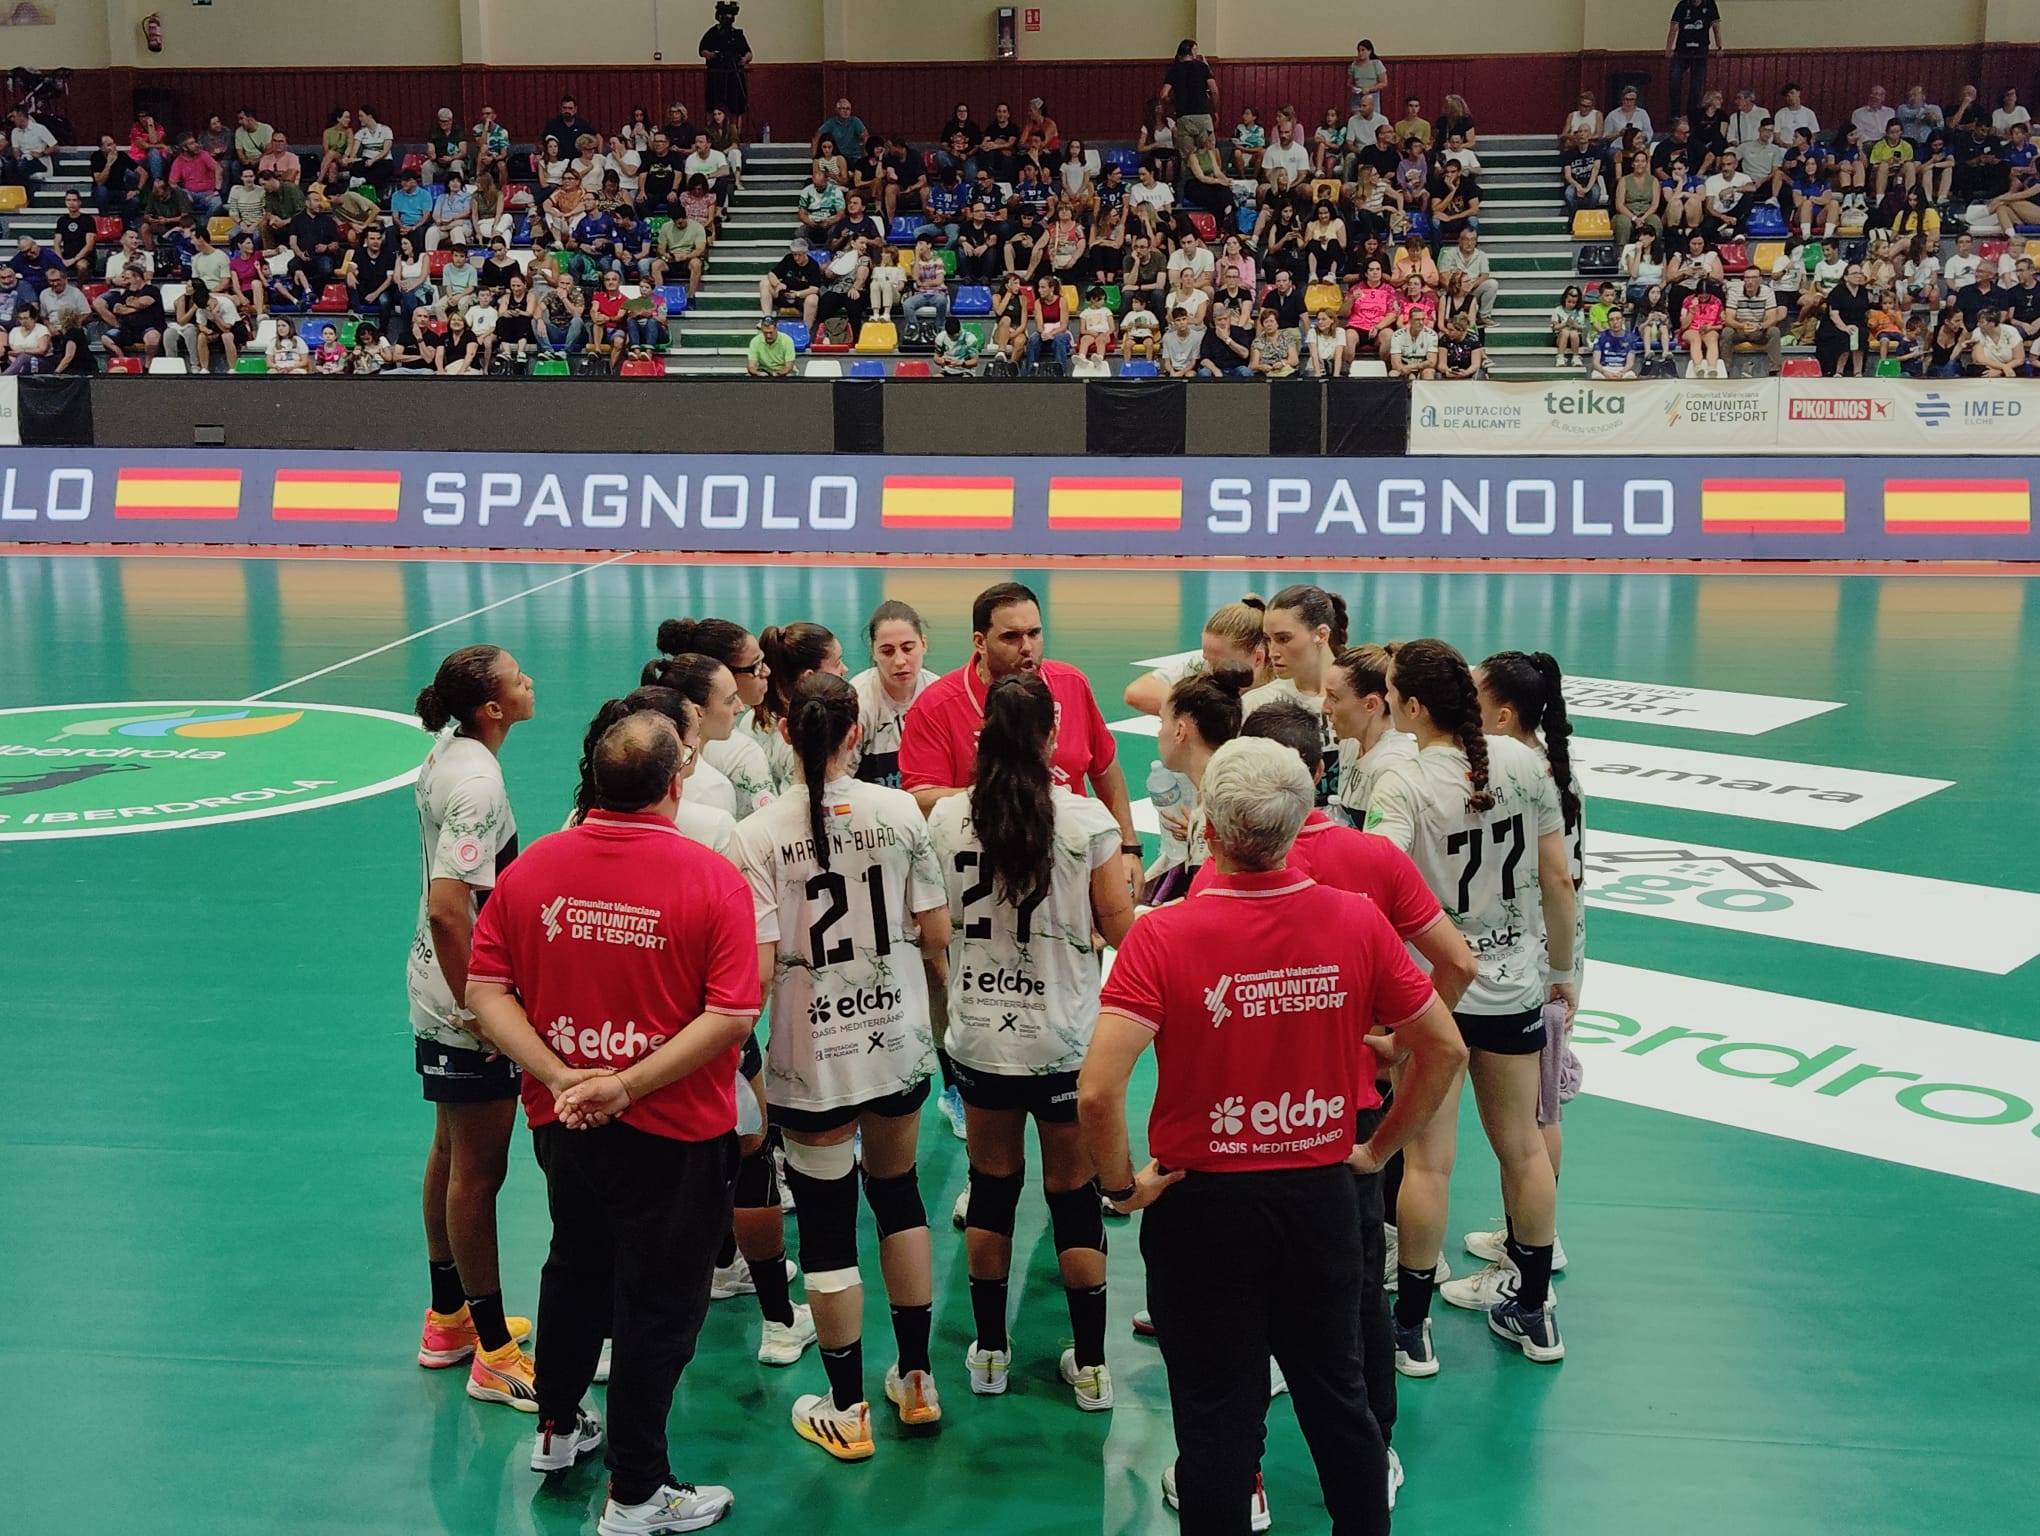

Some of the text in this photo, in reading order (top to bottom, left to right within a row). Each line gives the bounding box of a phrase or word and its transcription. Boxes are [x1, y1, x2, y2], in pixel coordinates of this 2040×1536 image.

[1443, 404, 1521, 416] DIPUTACIÓN
[1544, 389, 1625, 414] teika
[1686, 400, 1759, 411] COMUNITAT
[1792, 400, 1868, 419] PIKOLINOS
[1964, 400, 2022, 417] IMED
[1443, 418, 1521, 429] DE ALICANTE
[1551, 418, 1624, 434] EL BUEN VENDING
[1690, 411, 1769, 422] DE L'ESPORT
[1, 467, 94, 521] LO
[422, 472, 859, 530] SPAGNOLO
[1207, 478, 1675, 535] SPAGNOLO
[22, 778, 338, 825] IBERDROLA
[780, 826, 897, 866] MARN-BURO
[1447, 812, 1526, 914] 77
[1584, 874, 1795, 913] go
[567, 896, 661, 918] Comunitat Valenciana
[805, 863, 891, 969] 21
[566, 908, 659, 933] COMUNITAT
[571, 924, 668, 950] DE L'ESPORT
[978, 968, 1046, 996] elche
[1234, 964, 1340, 983] Comunitat Valenciana
[836, 984, 902, 1018] elche
[1234, 975, 1340, 1002] COMUNITAT
[1242, 991, 1348, 1018] DE L'ESPORT
[578, 1020, 667, 1061] elche
[811, 1026, 837, 1039] OASIS
[1250, 1088, 1346, 1136] elche
[1208, 1128, 1344, 1154] OASIS MEDITERRÁNEO
